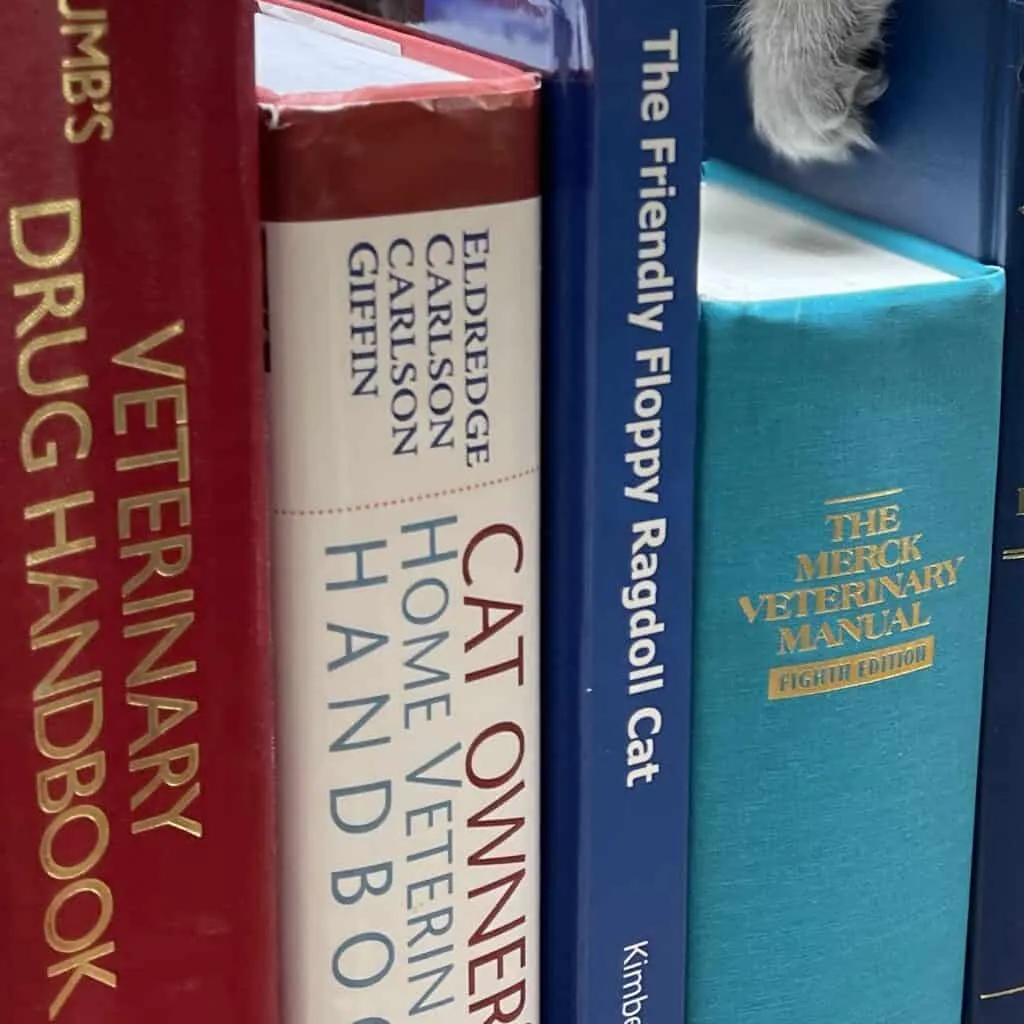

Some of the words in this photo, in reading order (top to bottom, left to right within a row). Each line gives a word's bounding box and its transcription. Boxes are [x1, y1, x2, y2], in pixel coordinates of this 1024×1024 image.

[640, 29, 680, 122] The
[346, 241, 380, 399] GIFFIN
[627, 137, 678, 332] Friendly
[8, 197, 94, 473] DRUG
[385, 237, 418, 457] CARLSON
[423, 232, 456, 450] CARLSON
[461, 228, 492, 468] ELDREDGE
[624, 346, 674, 504] Floppy
[111, 317, 204, 839] VETERINARY
[462, 523, 526, 687] CAT
[621, 518, 668, 695] Ragdoll
[738, 555, 965, 624] VETERINARY
[794, 532, 923, 583] MERCK
[824, 504, 902, 542] THE
[399, 515, 460, 731] HOME
[776, 601, 932, 656] MANUAL
[778, 662, 850, 692] EIGHTH
[857, 644, 926, 677] EDITION
[23, 489, 119, 1023] HANDBOOK
[324, 538, 396, 1024] HANDBO
[626, 707, 663, 787] Cat
[404, 741, 464, 1017] VETERIN
[465, 720, 528, 1024] OWNER
